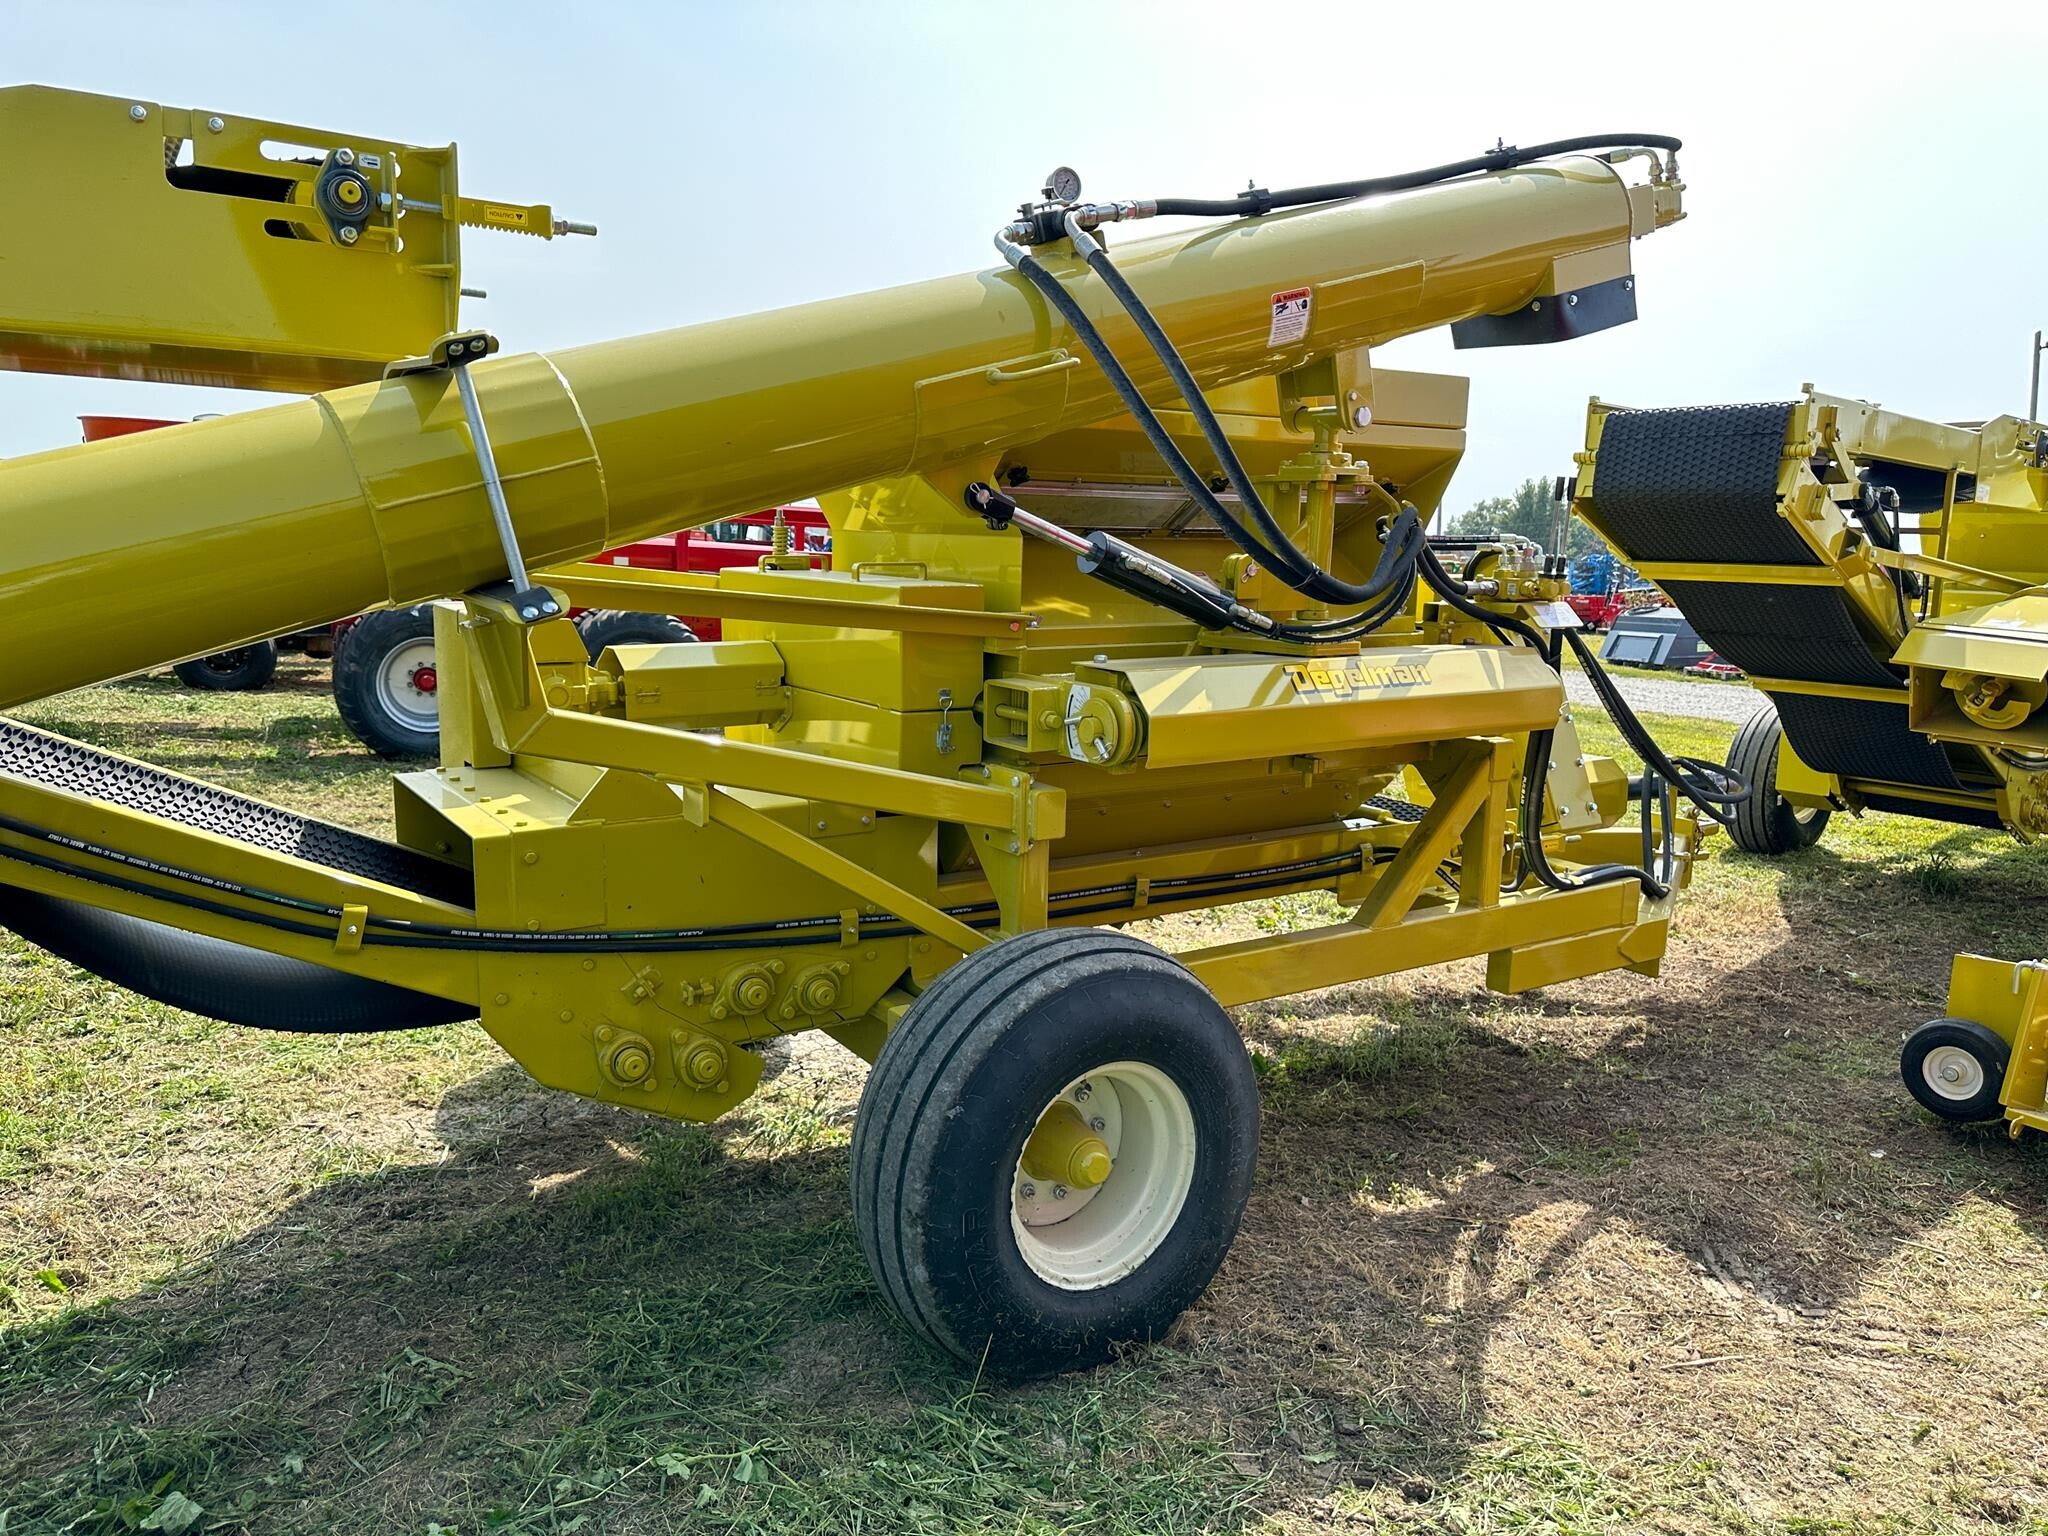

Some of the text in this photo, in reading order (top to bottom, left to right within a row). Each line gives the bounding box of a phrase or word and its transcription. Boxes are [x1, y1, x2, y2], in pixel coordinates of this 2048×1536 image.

[489, 211, 515, 219] CAUTION
[1283, 661, 1433, 698] Degelman
[47, 833, 62, 842] ITALY
[69, 839, 85, 848] MADE
